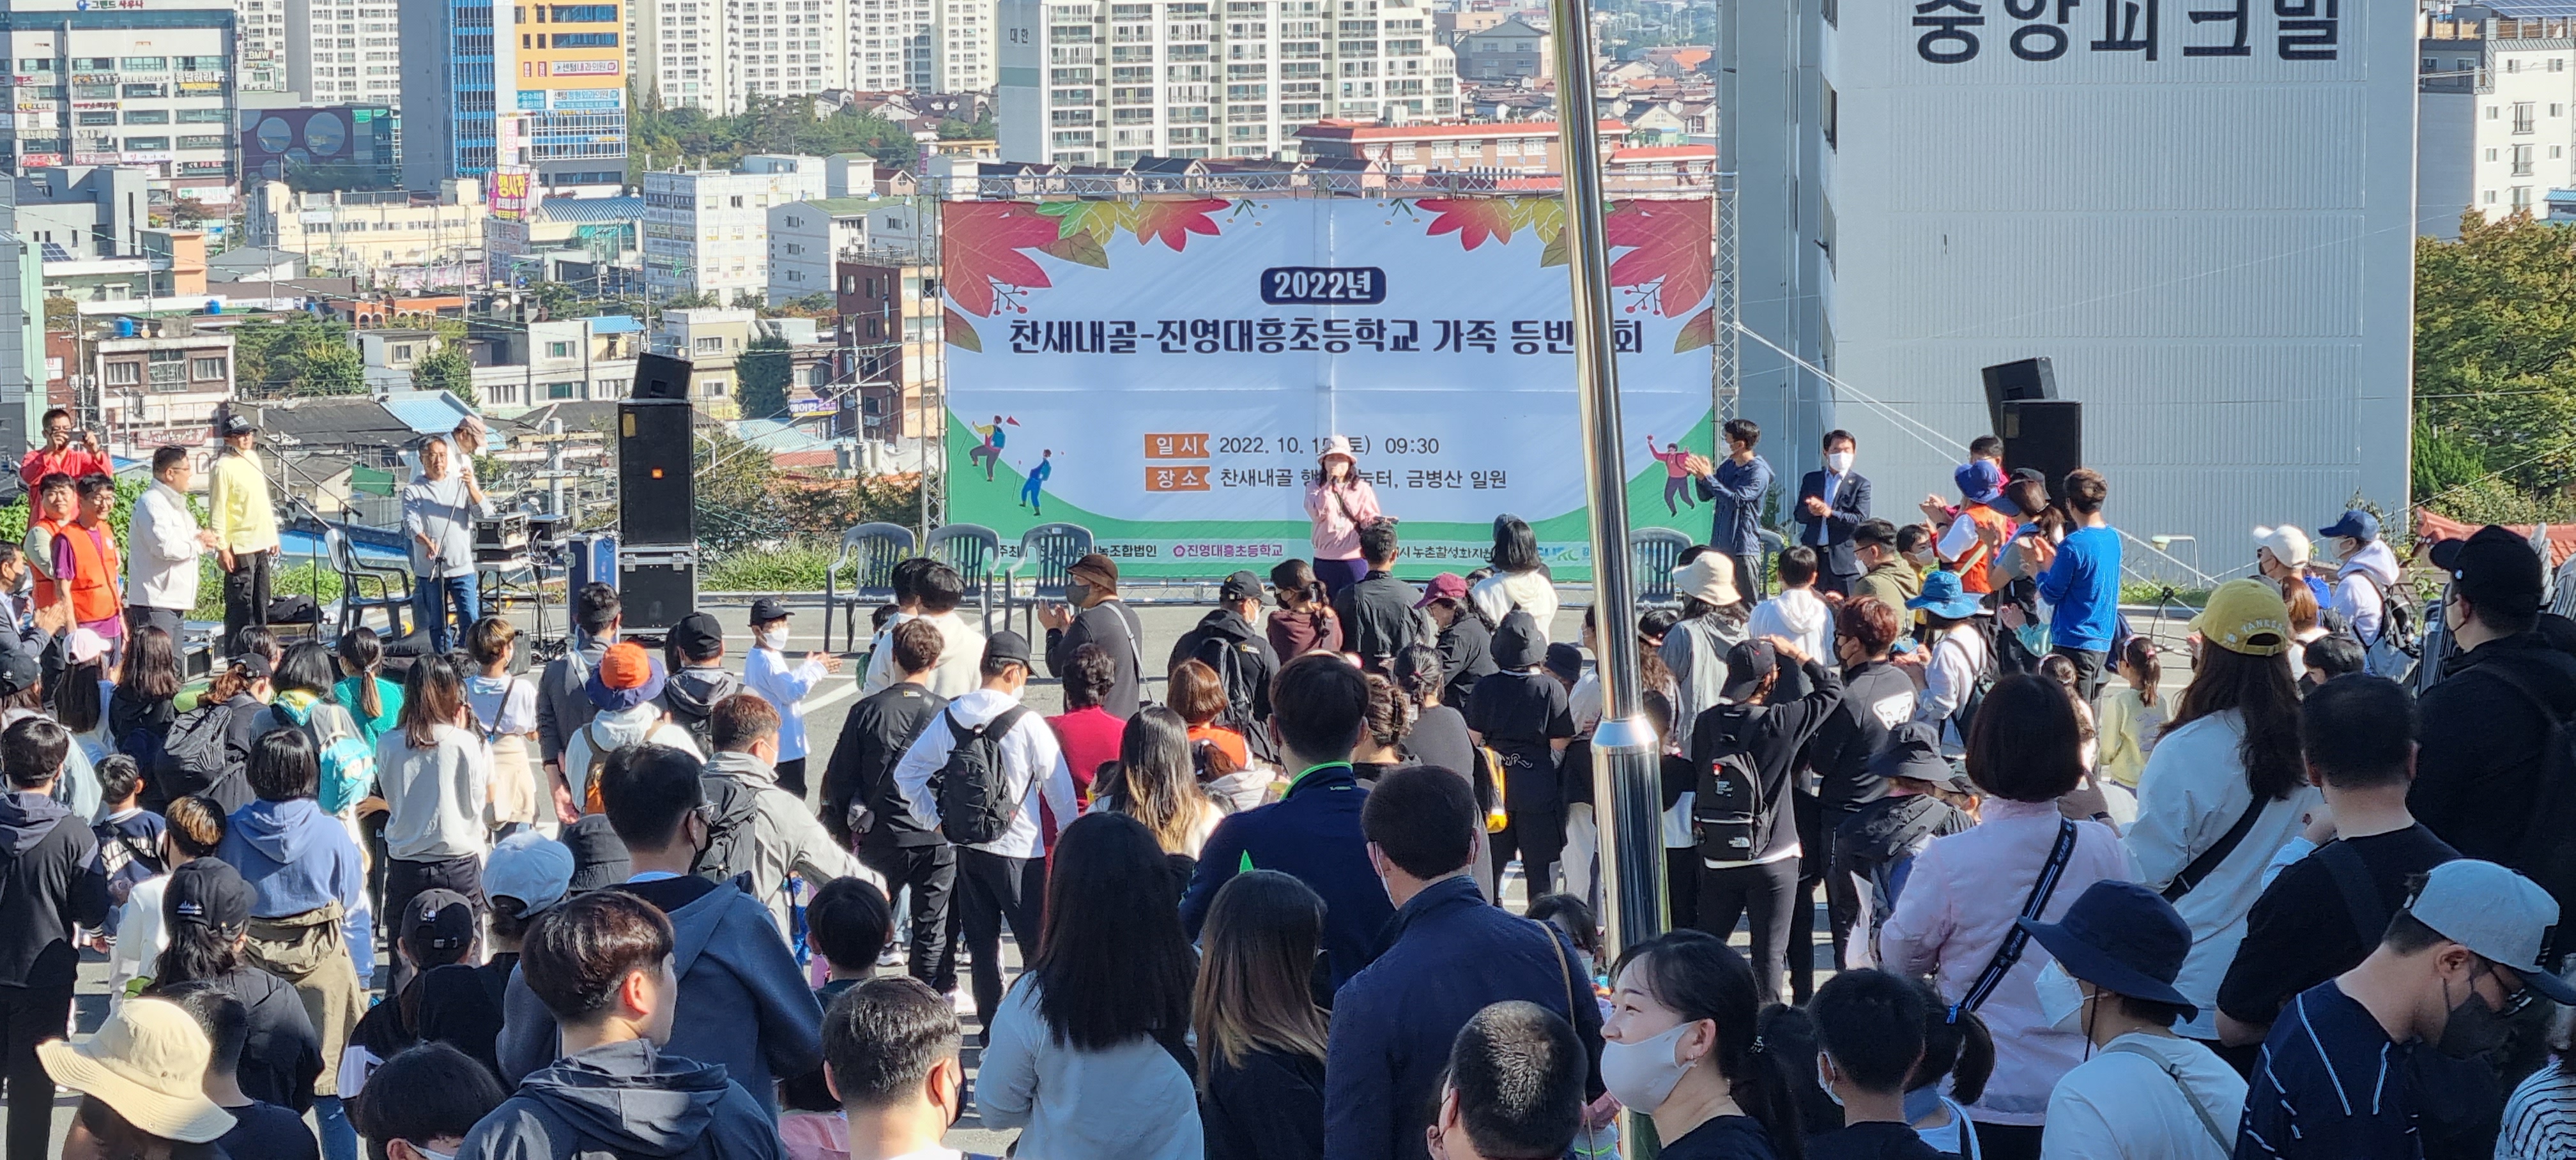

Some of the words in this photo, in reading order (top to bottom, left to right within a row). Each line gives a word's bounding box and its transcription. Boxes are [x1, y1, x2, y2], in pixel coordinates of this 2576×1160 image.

[1912, 0, 2338, 63] 중앙피크빌
[563, 62, 606, 72] 센텀내과의원
[1275, 271, 1371, 298] 2022년
[1009, 317, 1420, 355] 찬새내골-진영대흥초등학교
[1432, 319, 1496, 355] 가족
[1510, 319, 1643, 355] 등반회
[1219, 437, 1269, 454] 2022.
[1277, 437, 1304, 454] 10.
[1312, 434, 1370, 455] 1토)
[1384, 438, 1439, 454] 09:30
[1220, 469, 1294, 487] 찬새내골
[1301, 468, 1399, 489] 행눔터,
[1406, 469, 1463, 489] 금병산
[1470, 470, 1507, 489] 일원
[1187, 544, 1284, 558] 진영대흥초등학교
